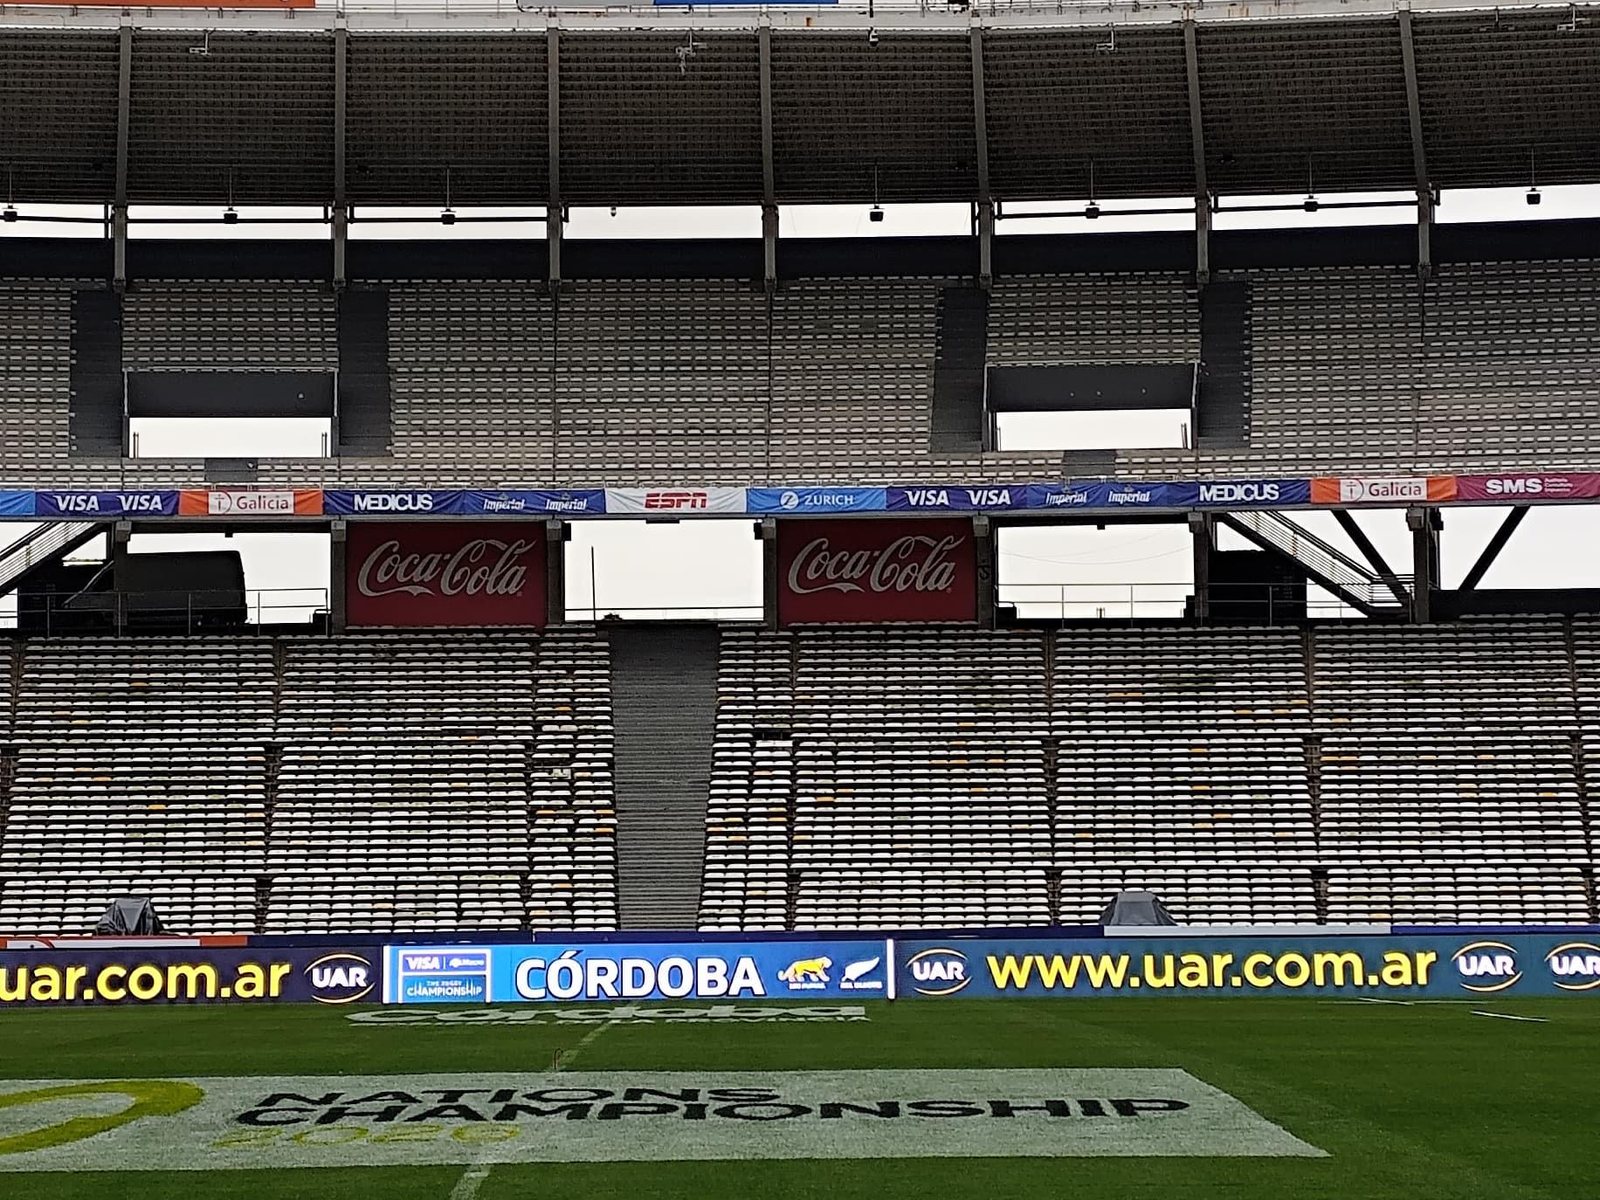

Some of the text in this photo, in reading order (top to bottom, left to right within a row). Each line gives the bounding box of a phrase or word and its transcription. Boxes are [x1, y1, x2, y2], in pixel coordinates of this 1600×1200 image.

[1200, 483, 1280, 502] MEDICUS
[1368, 482, 1422, 497] Galicia
[1485, 478, 1543, 495] SMS
[53, 494, 164, 511] VISA VISA
[236, 495, 289, 510] Galicia
[354, 494, 433, 511] MEDICUS
[484, 498, 588, 512] Imperial Imperial
[644, 493, 707, 509] ESPN
[805, 494, 855, 506] ZURICH
[905, 489, 1012, 506] VISA VISA
[1046, 489, 1151, 505] Imperial Imperial
[357, 539, 537, 597] Coca-Cola
[788, 535, 966, 593] Coca-Cola
[405, 956, 440, 970] VISA
[912, 961, 965, 982] UAR
[986, 951, 1437, 989] www.uar.com.ar
[1458, 955, 1516, 976] UAR
[1551, 955, 1600, 976] UAR
[0, 962, 291, 1001] uar.com.ar
[311, 966, 368, 988] UAR
[515, 950, 767, 1000] CÓRDOBA
[407, 980, 482, 996] CHAMPIONSHIP
[254, 1087, 779, 1107] NATIONS
[236, 1098, 1192, 1126] CHAMPIONSHIP
